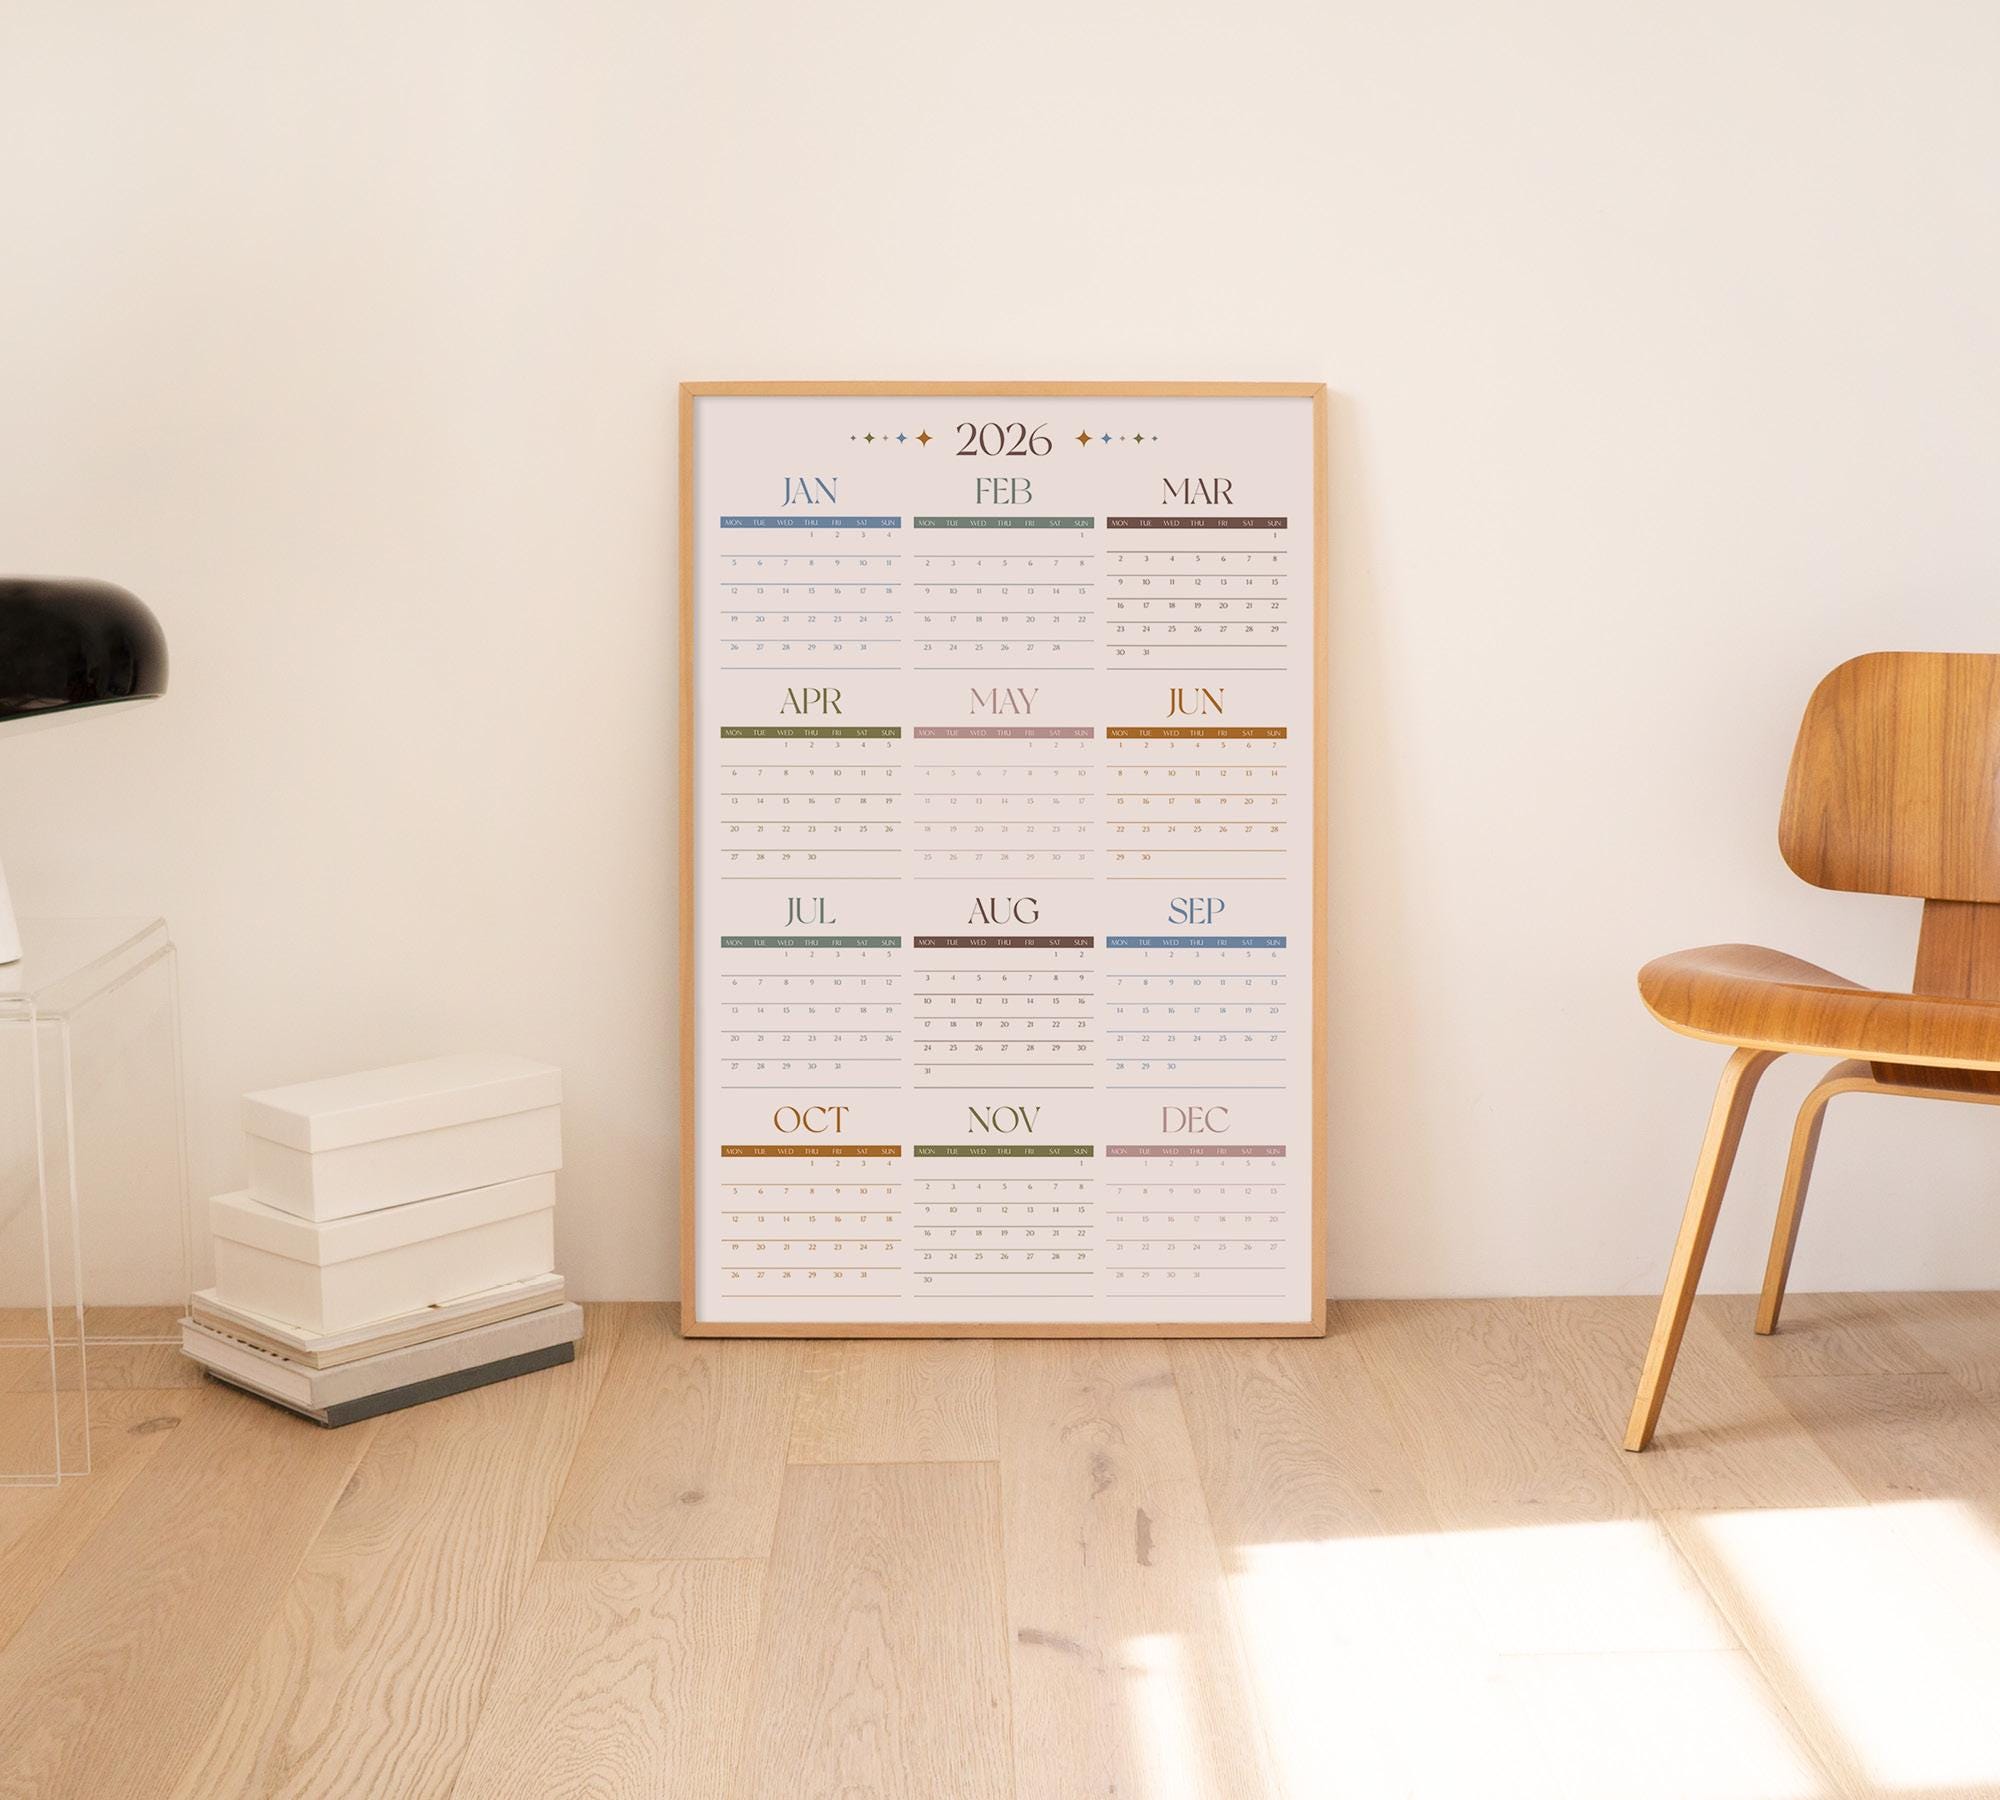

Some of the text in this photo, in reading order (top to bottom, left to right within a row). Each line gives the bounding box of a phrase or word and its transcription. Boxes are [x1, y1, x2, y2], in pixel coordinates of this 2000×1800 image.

[955, 422, 1053, 457] 2026
[781, 476, 838, 508] JAN
[976, 477, 1033, 505] FEB
[1161, 477, 1234, 505] MAR
[753, 519, 766, 527] TUE
[856, 519, 868, 527] SAT
[880, 519, 896, 527] SUN
[1111, 519, 1129, 527] MON
[1139, 519, 1151, 527] TUE
[1217, 519, 1228, 527] FRI
[1242, 519, 1254, 527] SAT
[1267, 520, 1282, 528] SUN
[1117, 601, 1125, 609] 16
[1143, 601, 1151, 609] 17
[1194, 601, 1202, 609] 19
[1218, 602, 1229, 610] 20
[1245, 601, 1253, 610] 21
[1270, 601, 1280, 610] 22
[730, 615, 894, 623] 19 20 21 22 23 24 25
[924, 615, 1087, 624] 16 17 18 19 20 21 22
[1116, 648, 1150, 656] 30 31
[779, 687, 843, 715] APR
[969, 687, 1040, 715] MAY
[1166, 687, 1225, 719] JUN
[753, 729, 766, 737] TUE
[804, 729, 819, 737] THU
[856, 729, 868, 737] SAT
[881, 729, 896, 737] SUN
[1111, 729, 1129, 737] MON
[1139, 729, 1151, 737] TUE
[1163, 729, 1180, 737] WED
[1190, 729, 1205, 737] THU
[1217, 729, 1228, 737] FRI
[1241, 729, 1254, 737] SAT
[731, 797, 739, 805] 13
[782, 797, 791, 805] 15
[834, 797, 842, 805] 17
[885, 797, 894, 805] 19
[1116, 797, 1278, 806] 15 16 17 18 19 20 21
[784, 896, 837, 928] JUL
[967, 896, 1040, 925] AUG
[1167, 896, 1226, 925] SEP
[946, 938, 959, 946] TUE
[970, 938, 987, 946] WED
[730, 1034, 894, 1042] 20 21 22 23 24 25 26
[1116, 1034, 1279, 1043] 21 22 23 24 25 26 27
[924, 1067, 932, 1075] 31
[773, 1105, 850, 1134] OCT
[967, 1105, 1041, 1134] NOV
[1162, 1105, 1230, 1134] DEC
[832, 1147, 842, 1155] FRI
[946, 1147, 958, 1155] TUE
[1048, 1147, 1061, 1155] SAT
[923, 1229, 1087, 1237] 16 17 18 19 20 21 22
[731, 1243, 894, 1251] 19 20 21 22 23 24 25
[923, 1276, 933, 1284] 30
